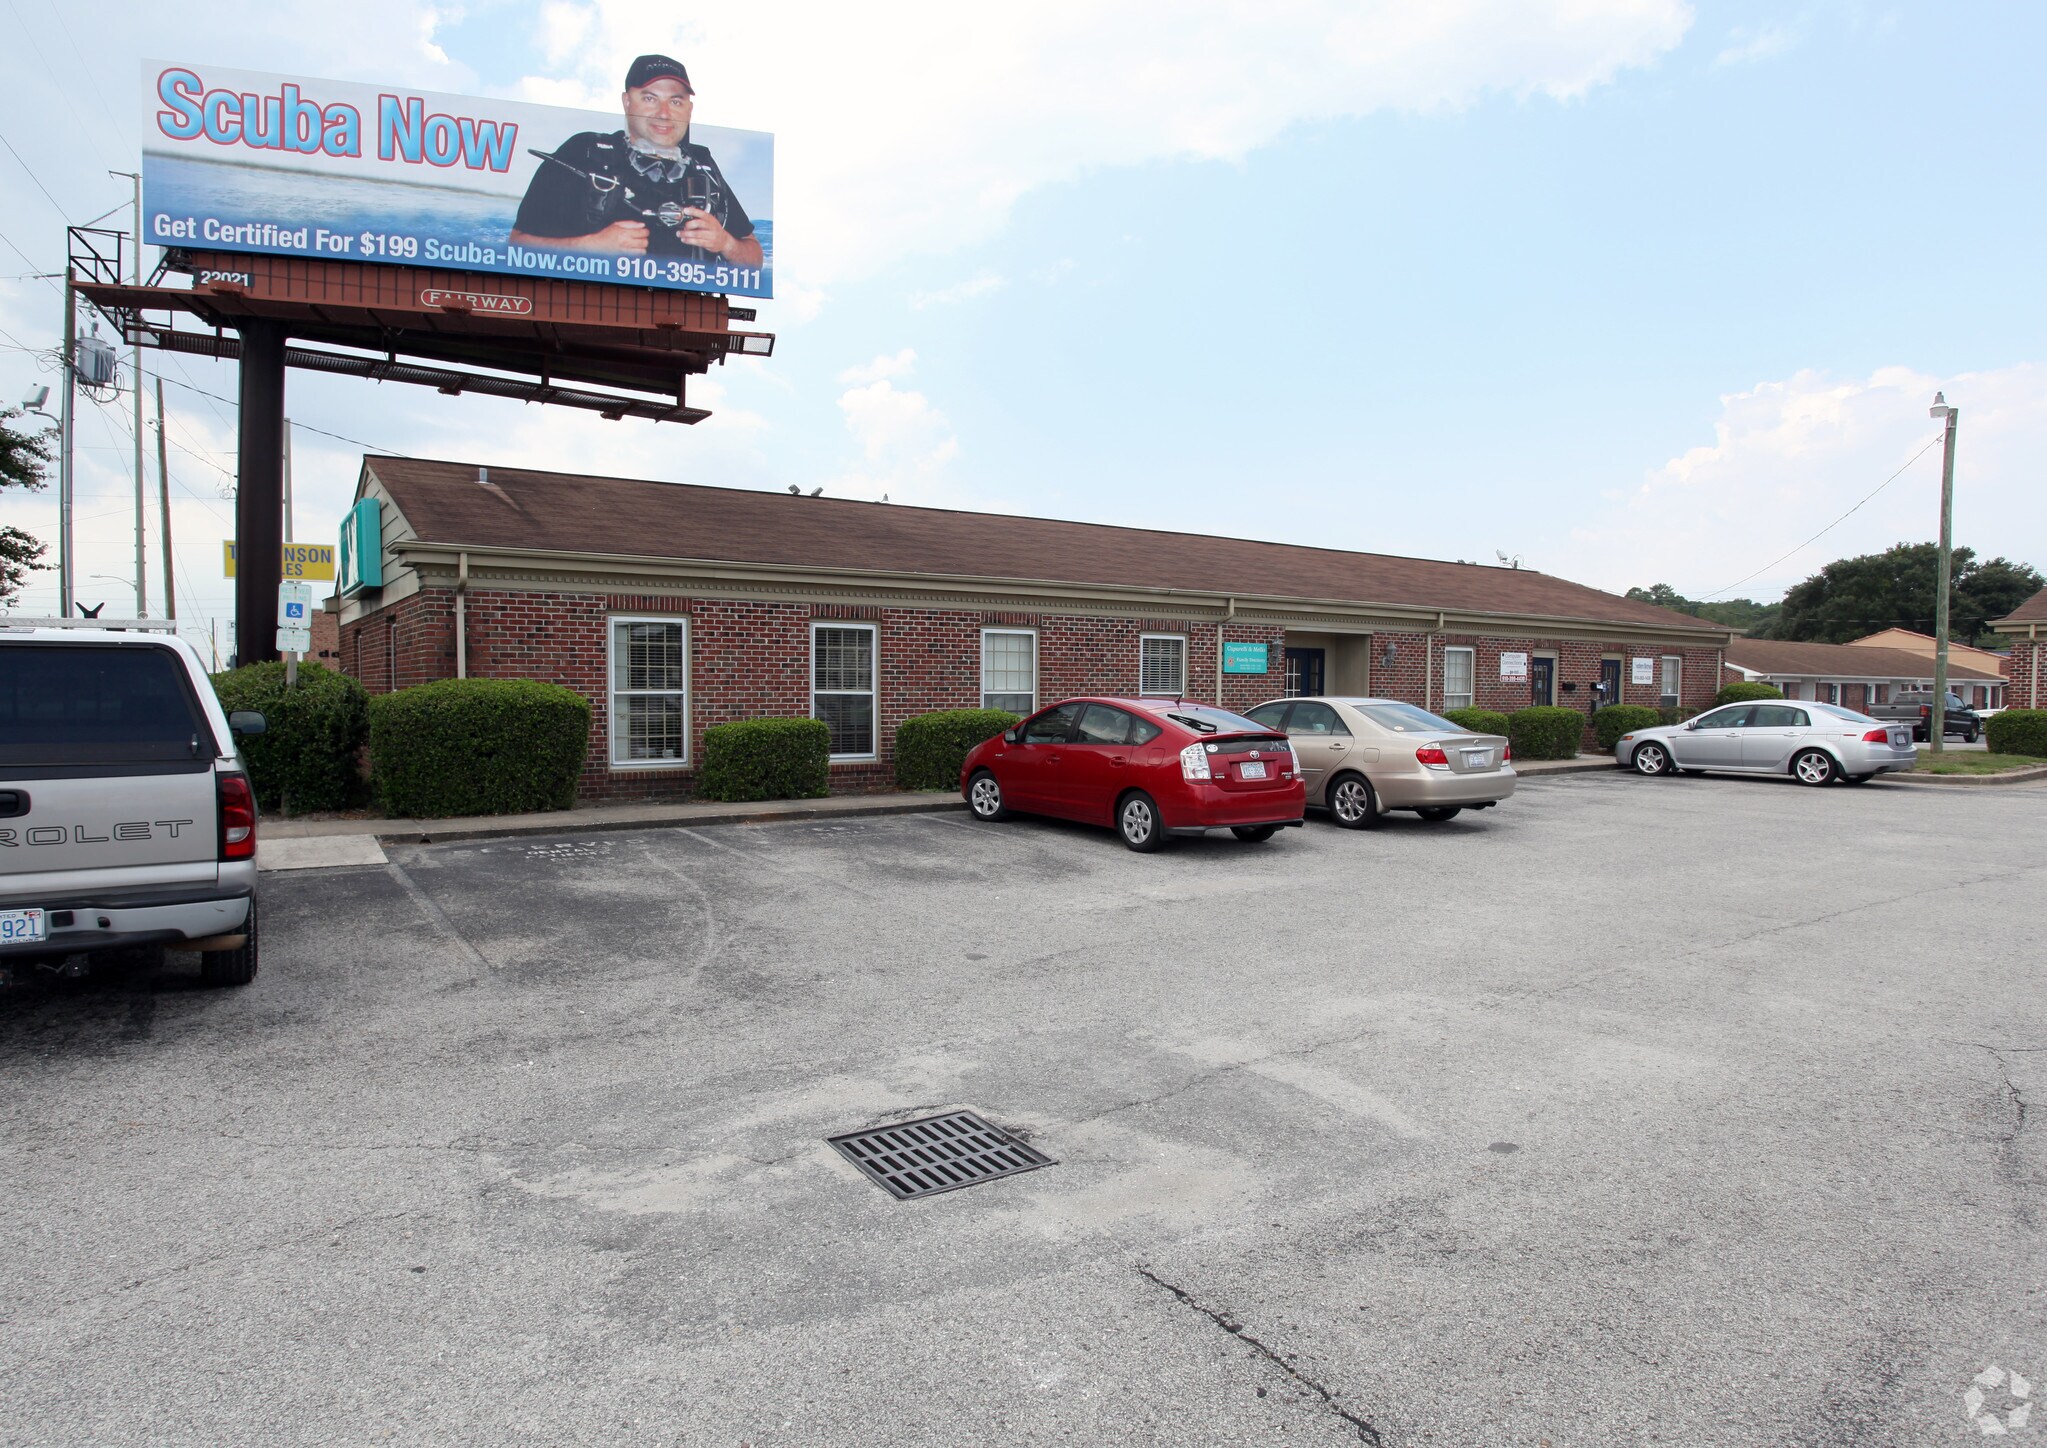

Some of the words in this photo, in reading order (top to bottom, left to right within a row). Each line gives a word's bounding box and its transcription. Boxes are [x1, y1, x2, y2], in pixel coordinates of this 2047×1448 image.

[157, 68, 362, 158] Scuba
[377, 94, 519, 173] Now
[154, 214, 197, 239] Get
[203, 218, 308, 249] Certified
[316, 229, 354, 252] For
[360, 232, 418, 257] $199
[424, 241, 610, 276] Scuba-Now.com
[616, 256, 761, 290] 910-395-5111
